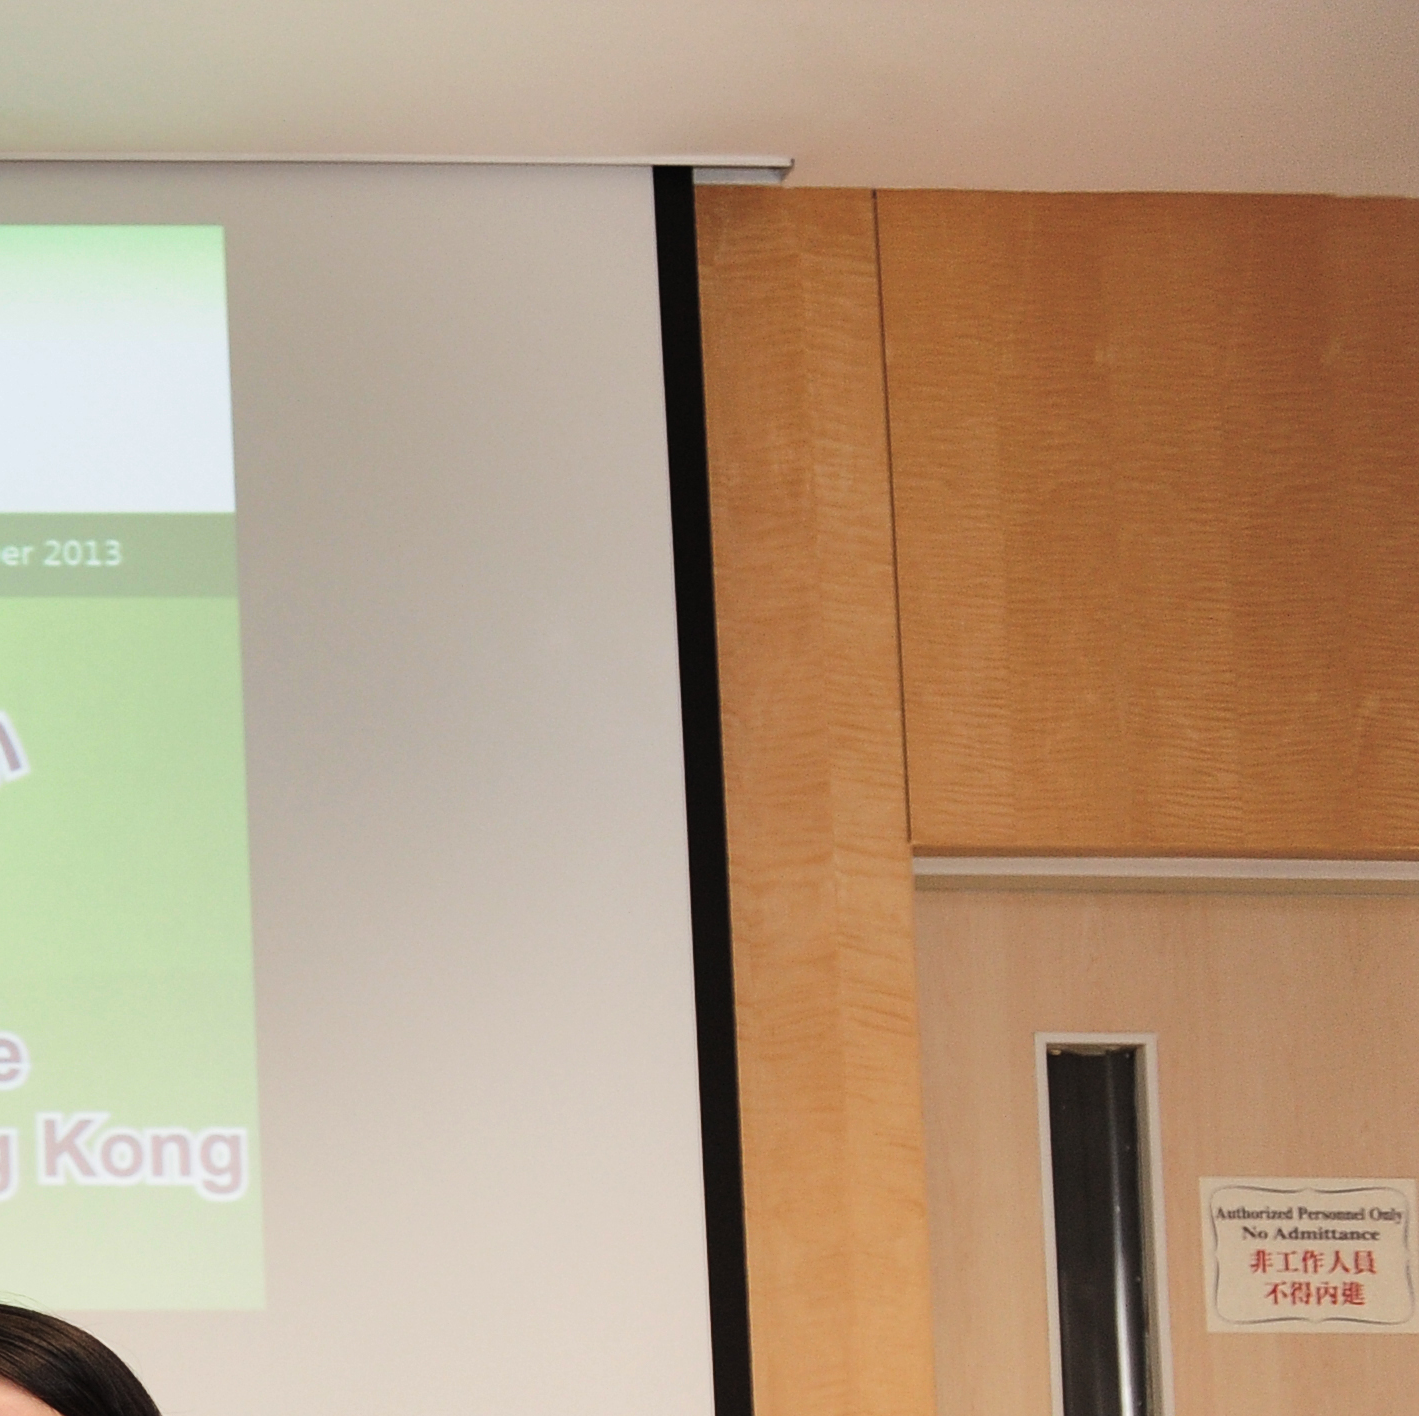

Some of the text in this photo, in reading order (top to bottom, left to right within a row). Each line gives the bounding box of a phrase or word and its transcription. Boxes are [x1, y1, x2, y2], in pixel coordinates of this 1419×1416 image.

[43, 539, 123, 567] 2013
[42, 1116, 245, 1196] Kong
[1216, 1206, 1403, 1225] Authorized Personnel Only
[1243, 1226, 1381, 1241] No Admittance
[1250, 1249, 1377, 1274] 非工作人員
